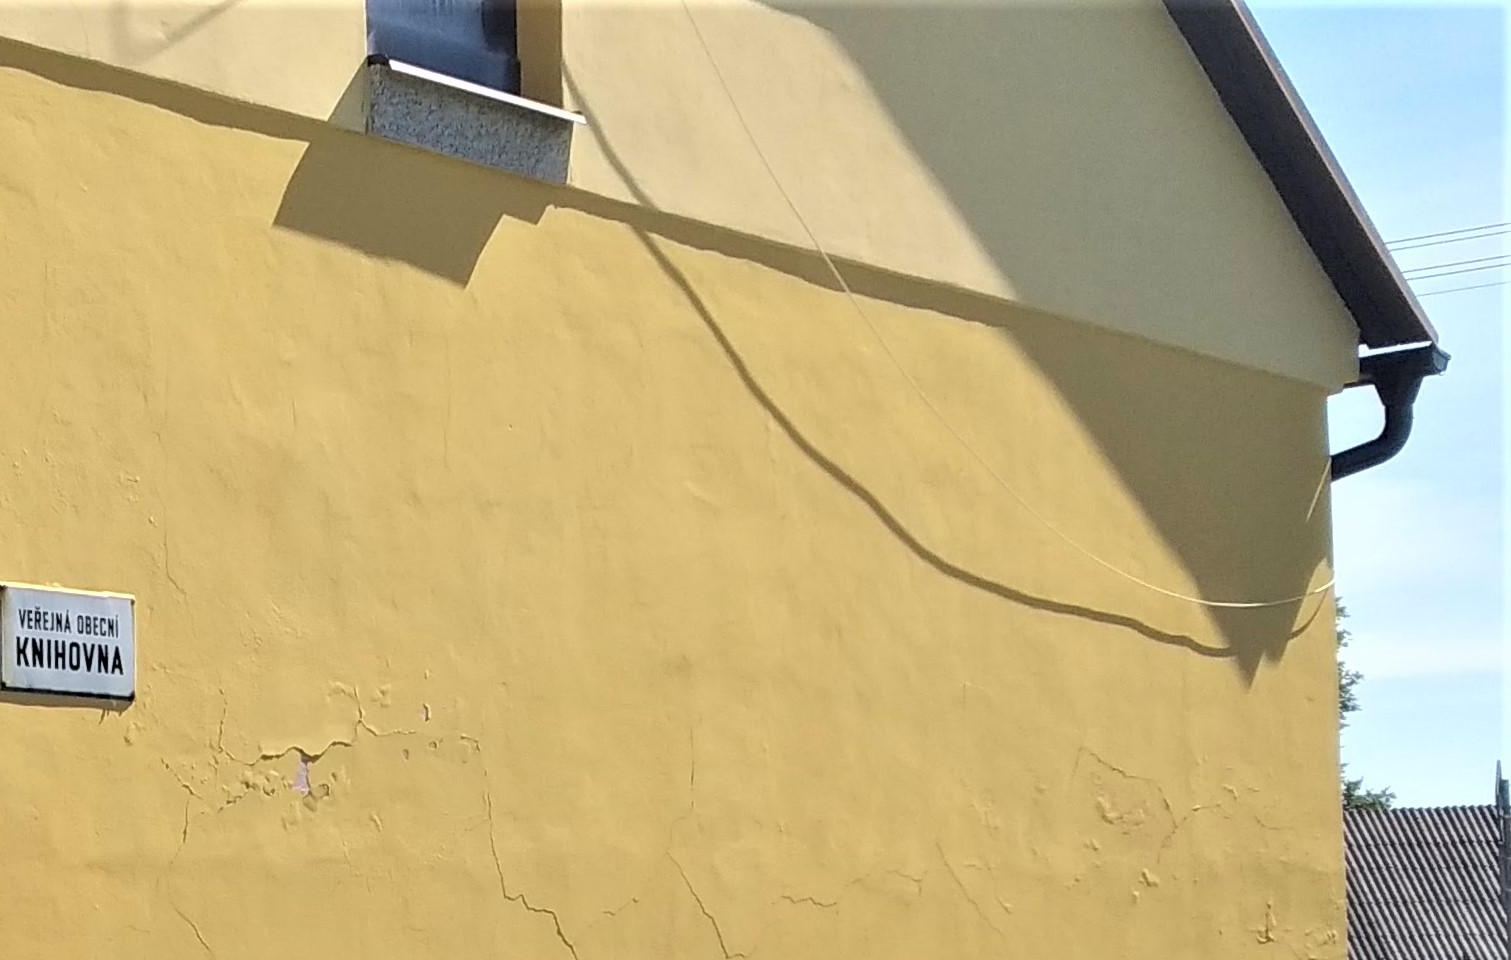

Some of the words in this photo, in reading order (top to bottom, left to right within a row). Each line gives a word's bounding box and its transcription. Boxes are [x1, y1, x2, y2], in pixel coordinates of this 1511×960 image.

[18, 606, 71, 634] VEŘEJNÁ
[77, 614, 120, 639] OBECNÍ
[15, 636, 125, 676] KNIHOVNA
